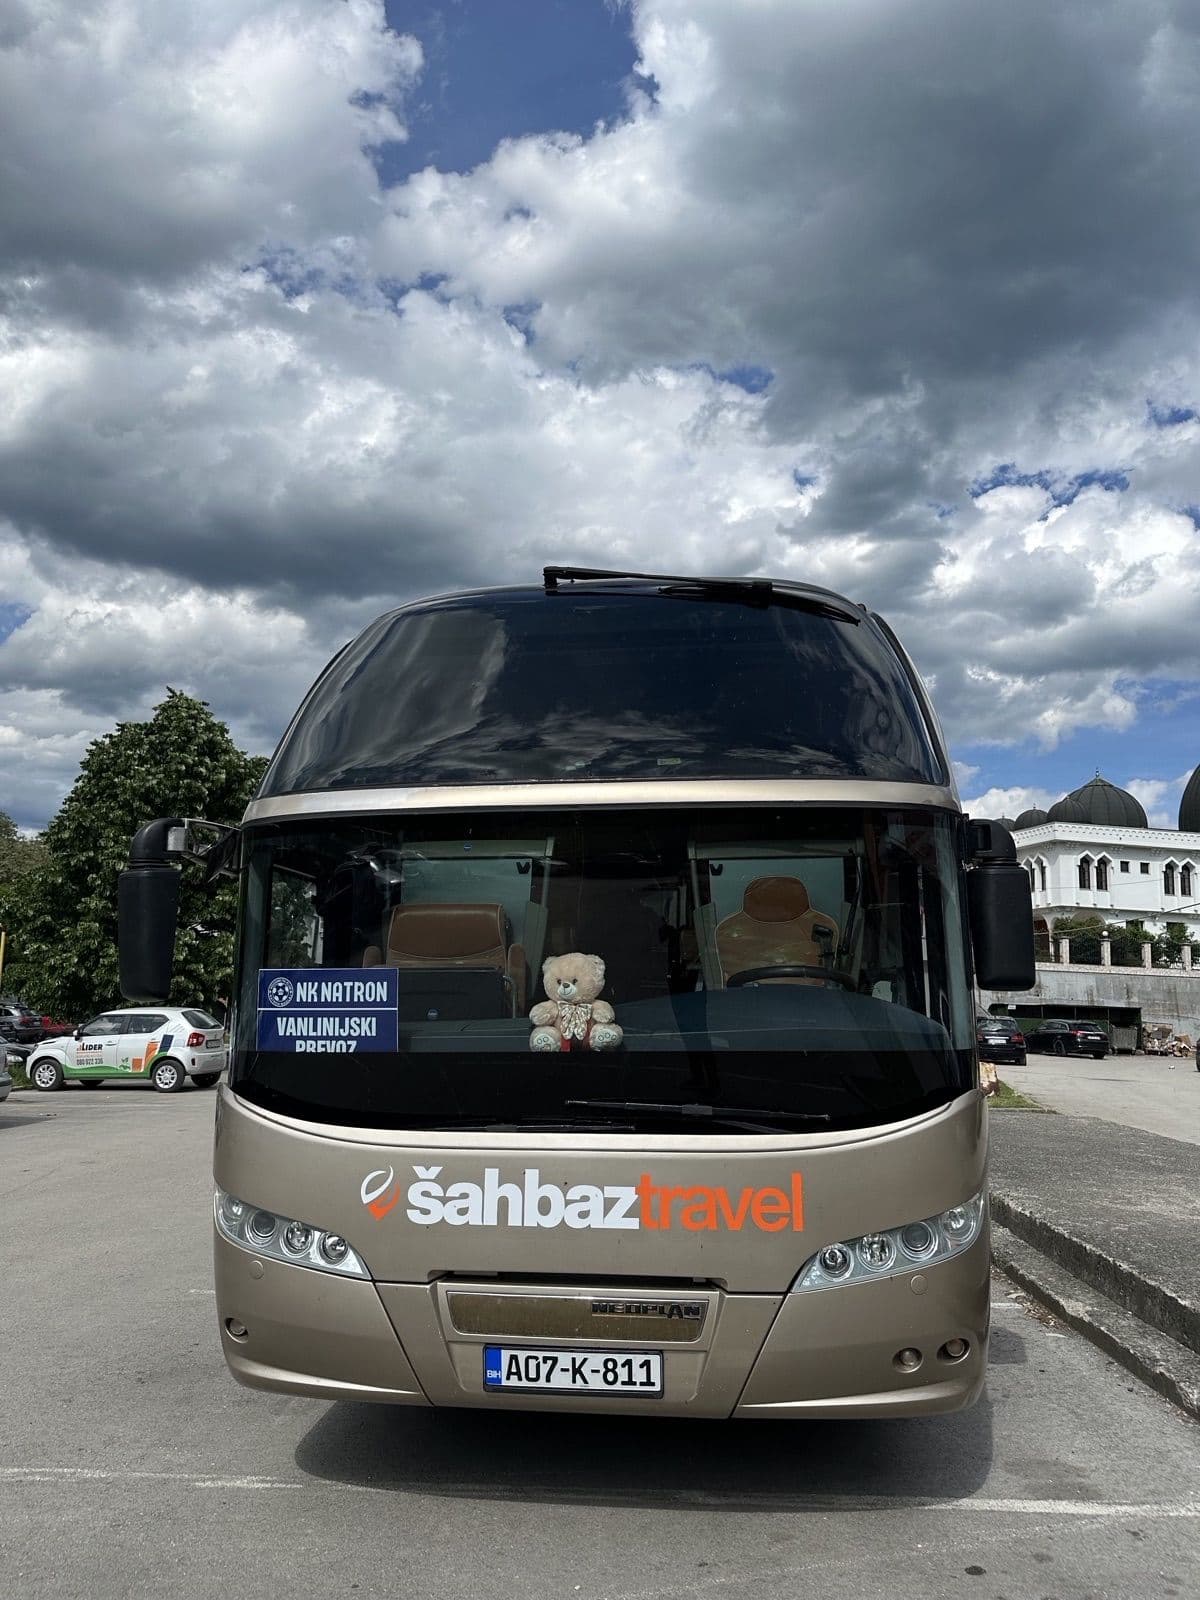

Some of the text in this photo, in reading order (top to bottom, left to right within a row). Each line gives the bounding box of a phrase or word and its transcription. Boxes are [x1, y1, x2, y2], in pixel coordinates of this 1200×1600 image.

[296, 981, 318, 1002] NK
[320, 981, 388, 1002] NATRON
[276, 1017, 377, 1037] VANLINIJSKI
[81, 1042, 103, 1051] LIDER
[592, 1303, 700, 1319] NEOPLAN
[505, 1354, 656, 1387] A07-K-811
